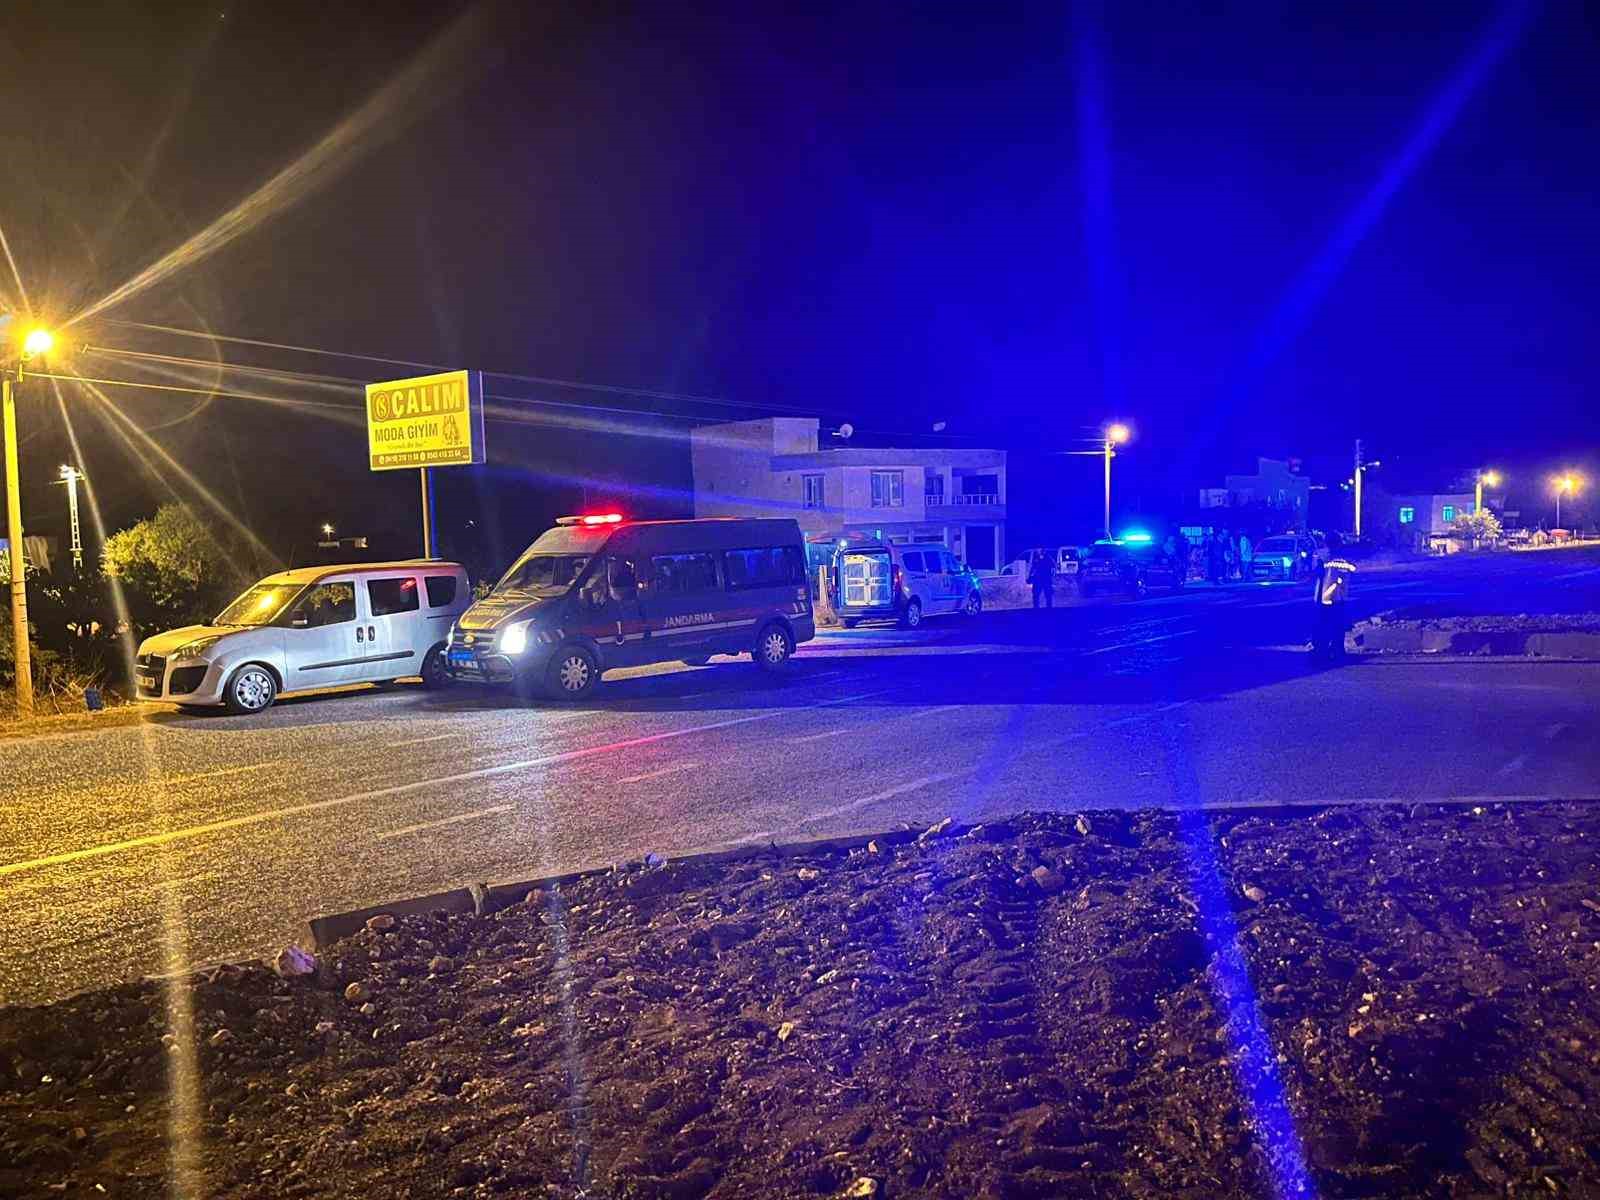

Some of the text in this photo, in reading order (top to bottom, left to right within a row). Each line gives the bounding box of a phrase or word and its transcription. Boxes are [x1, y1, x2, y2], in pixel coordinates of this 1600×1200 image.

[375, 419, 439, 442] MODA GİYİM
[664, 612, 715, 628] JANDARMA
